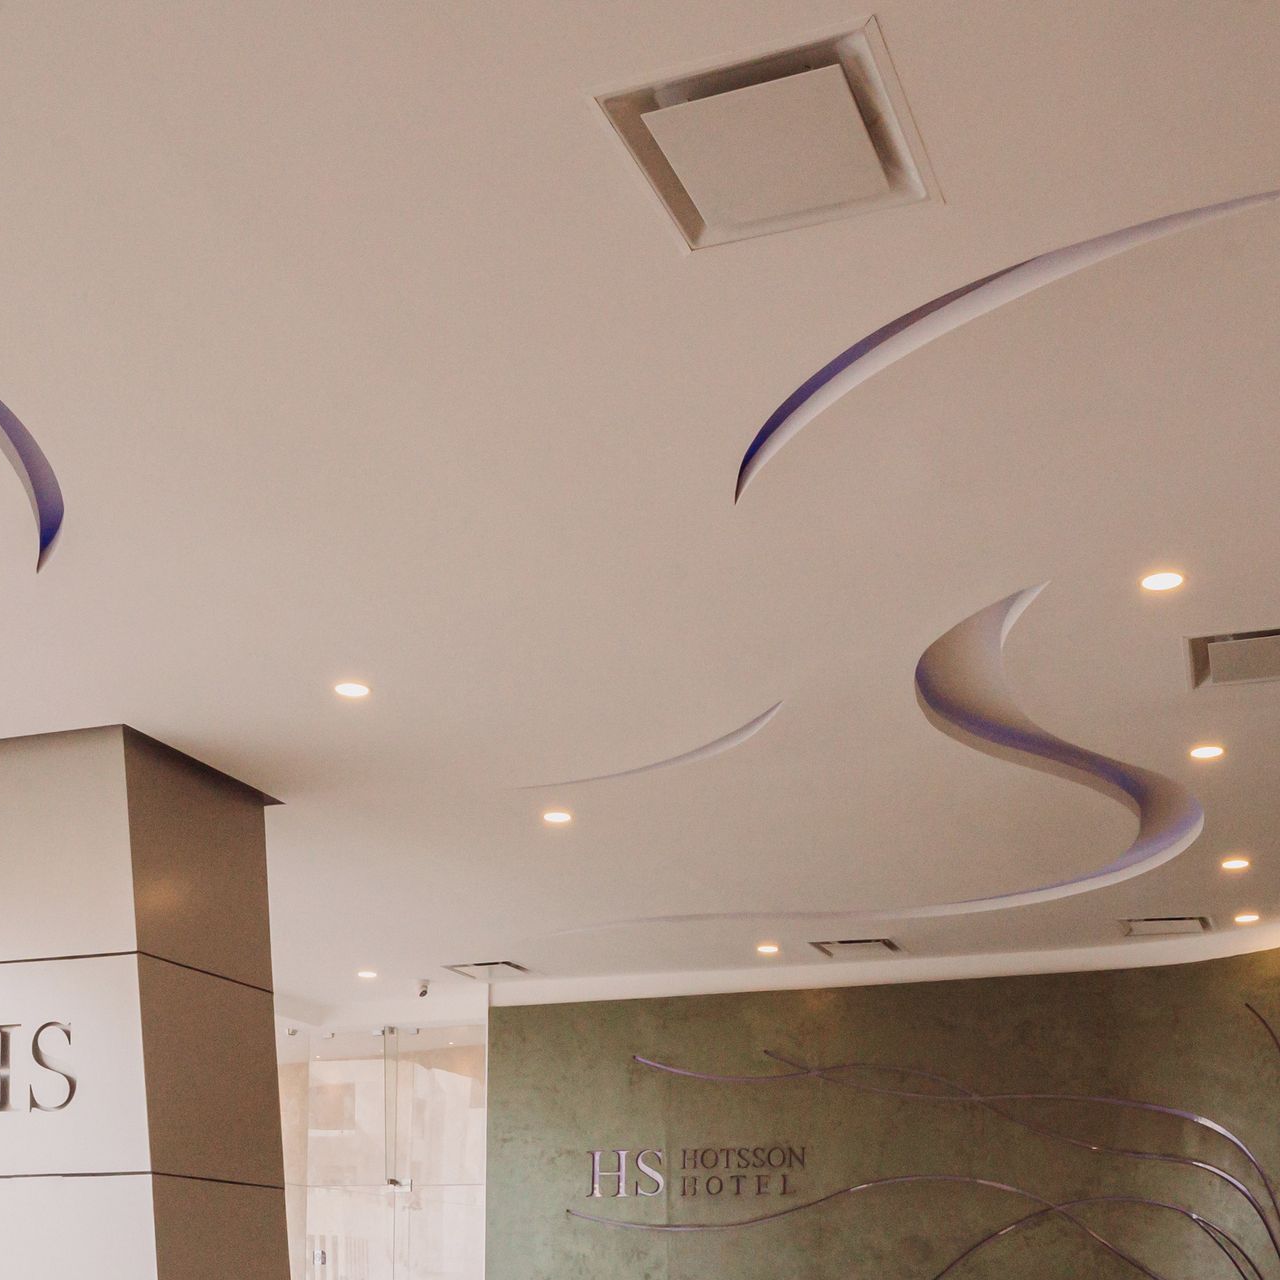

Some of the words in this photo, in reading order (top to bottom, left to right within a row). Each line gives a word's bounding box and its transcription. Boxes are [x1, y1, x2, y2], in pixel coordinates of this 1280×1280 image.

[585, 1149, 665, 1198] HS
[681, 1146, 807, 1170] HOTSSON
[681, 1174, 798, 1197] HOTEL
